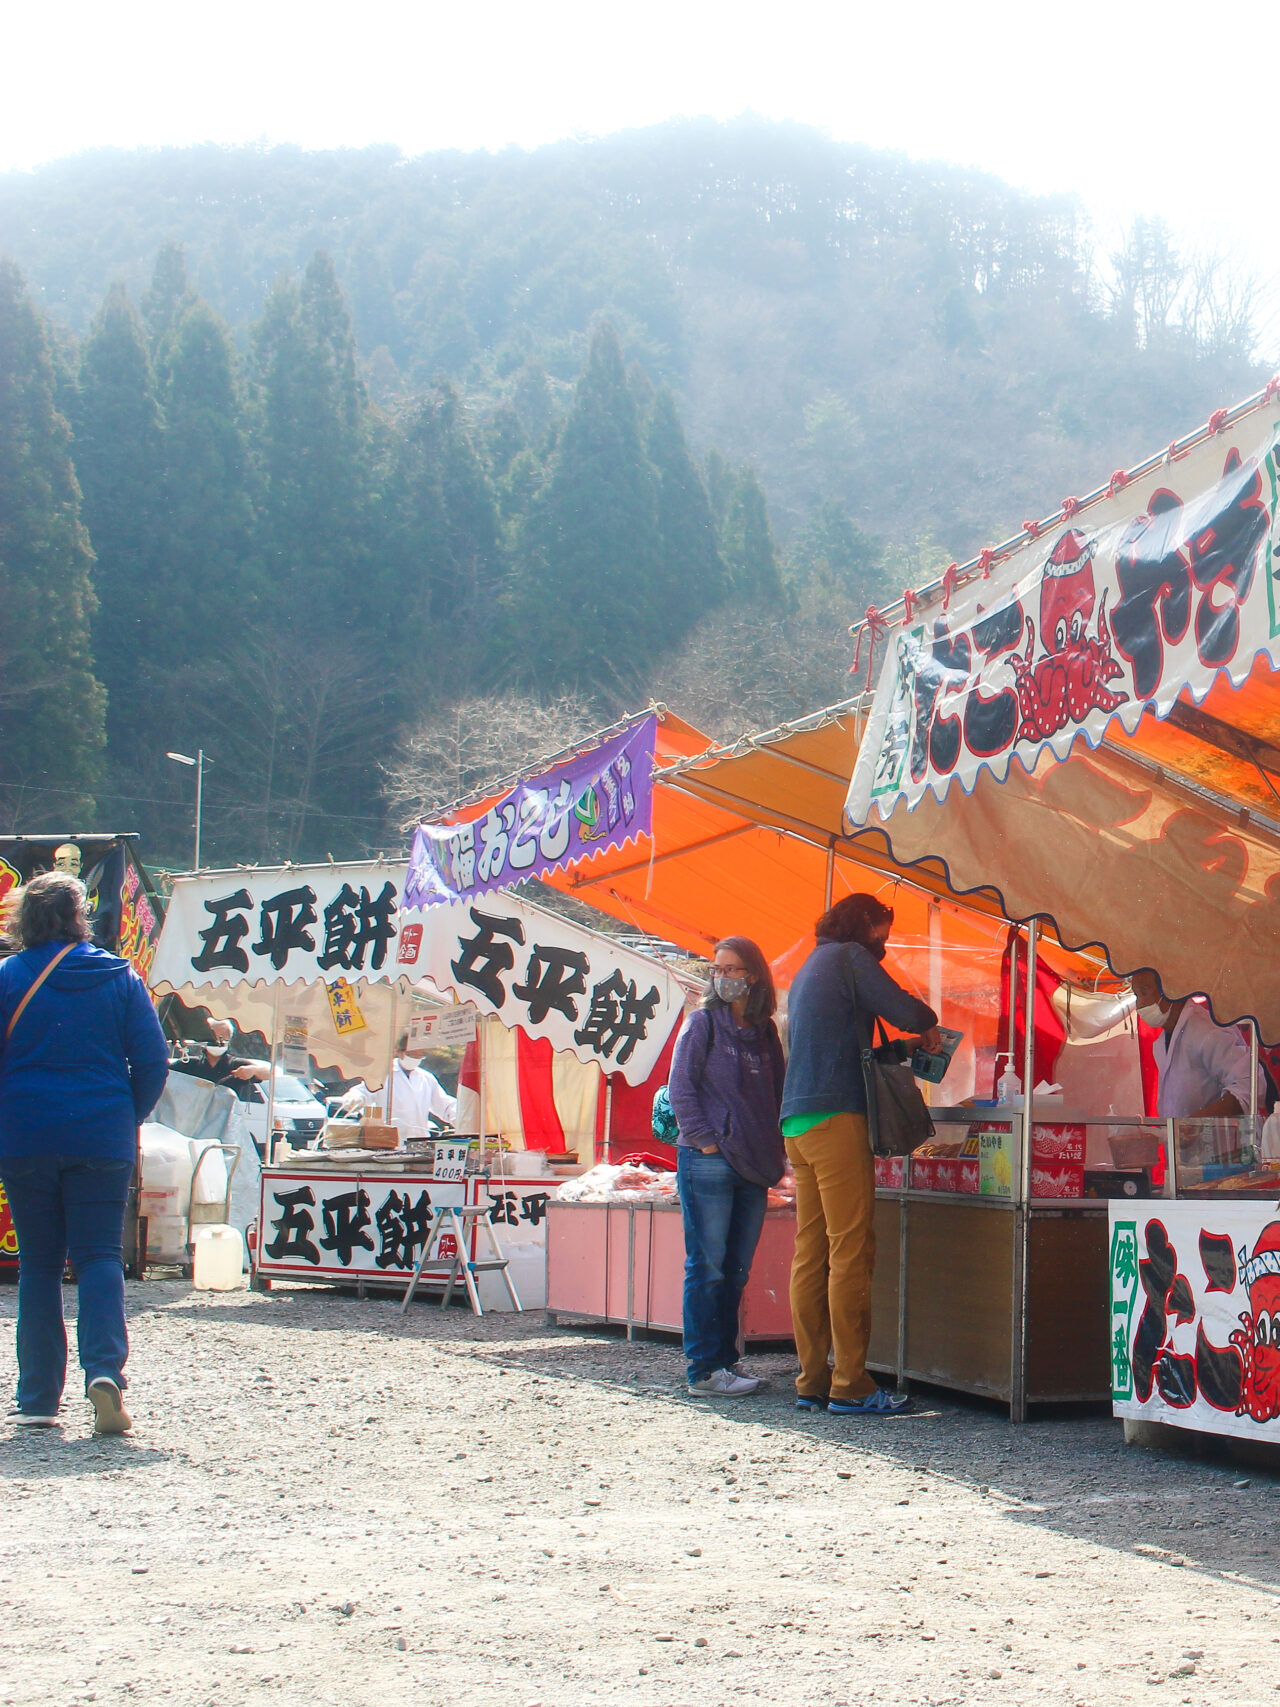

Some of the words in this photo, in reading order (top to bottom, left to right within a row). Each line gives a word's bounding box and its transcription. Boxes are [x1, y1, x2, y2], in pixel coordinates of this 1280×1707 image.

[191, 881, 400, 975] 五平餅
[449, 906, 660, 1067] 五平餅
[265, 1186, 434, 1270] 五平餅
[1111, 1235, 1138, 1388] 味一番
